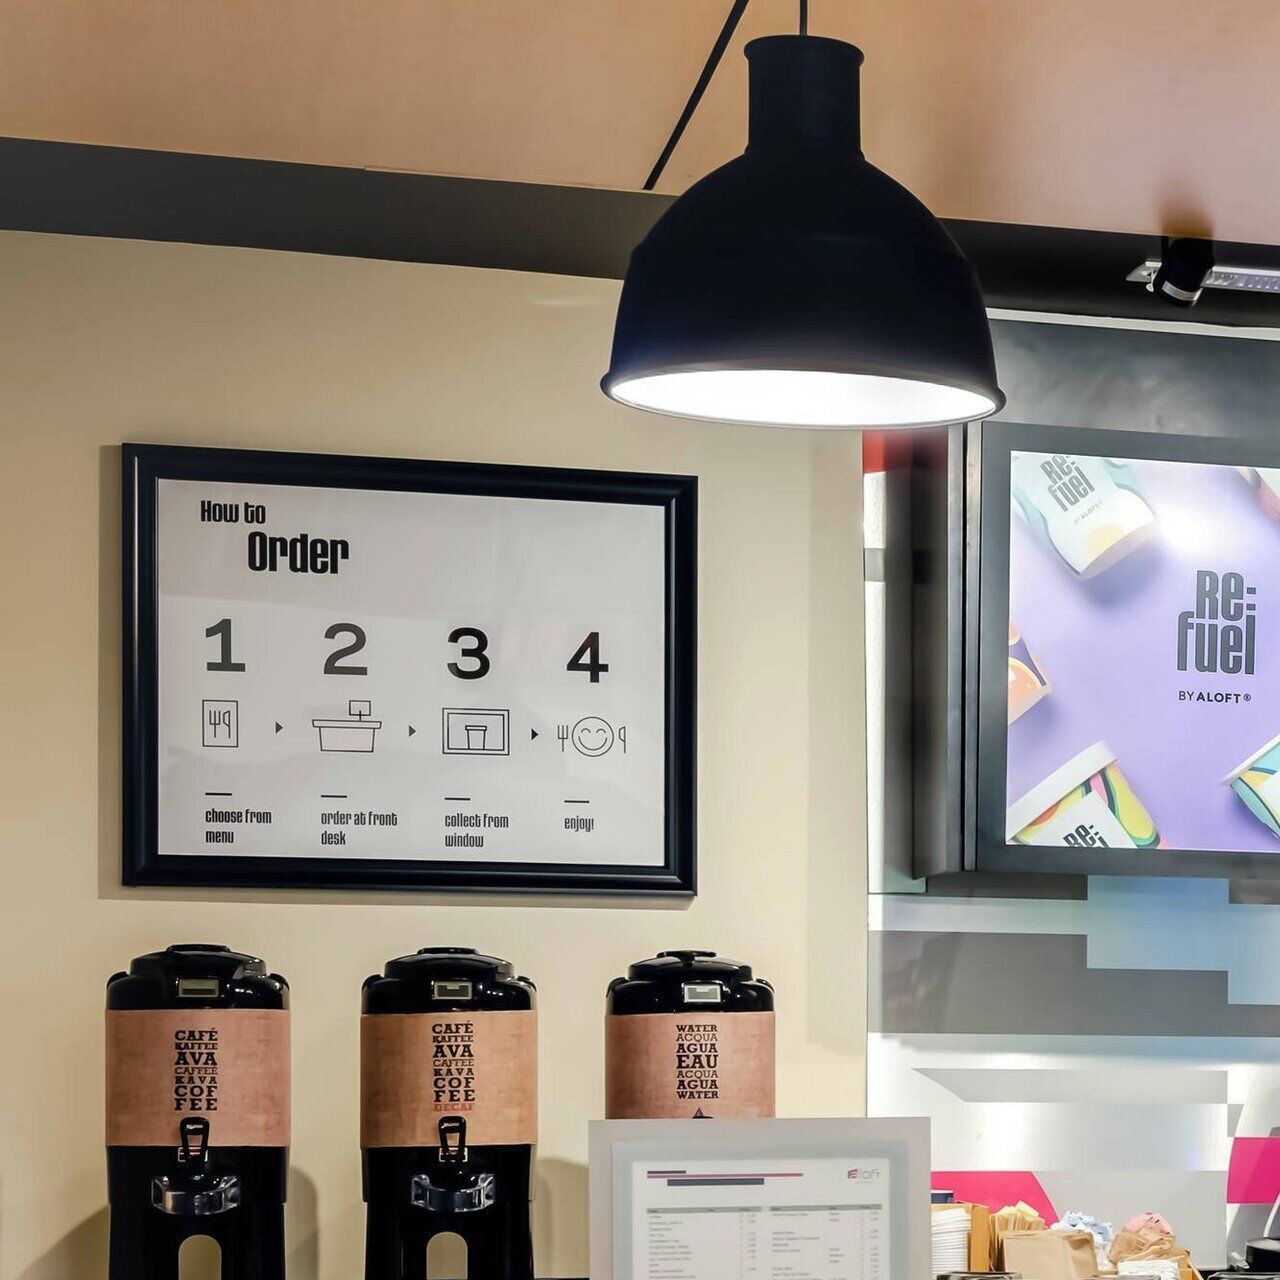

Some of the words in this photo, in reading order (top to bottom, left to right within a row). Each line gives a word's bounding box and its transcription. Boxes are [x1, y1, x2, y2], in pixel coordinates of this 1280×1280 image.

[1048, 466, 1095, 512] fuel
[201, 500, 239, 523] How
[244, 502, 266, 524] to
[248, 531, 349, 574] Order
[1196, 570, 1256, 622] Re:
[1177, 611, 1256, 675] fuel
[206, 619, 245, 672] 1
[324, 623, 367, 675] 2
[447, 627, 490, 680] 3
[567, 632, 608, 683] 4
[1178, 690, 1194, 701] BY
[206, 808, 242, 823] choose
[245, 809, 271, 823] from
[321, 811, 351, 825] order
[354, 812, 366, 825] at
[369, 811, 397, 826] front
[445, 813, 481, 827] collect
[483, 814, 508, 828] from
[565, 815, 594, 832] enjoy!
[206, 831, 234, 843] menu
[321, 831, 345, 845] desk
[445, 833, 483, 847] window
[174, 1027, 218, 1041] CAFÉ
[432, 1020, 474, 1034] CAFÉ
[676, 1033, 718, 1042] ACQUA
[432, 1044, 474, 1058] AVA
[676, 1043, 718, 1053] AGUA
[174, 1052, 218, 1065] AVA
[676, 1055, 718, 1069] EAU
[676, 1070, 718, 1079] ACQUA
[433, 1077, 475, 1089] COF
[677, 1080, 719, 1090] AGUA
[174, 1085, 218, 1097] COF
[434, 1090, 476, 1102] FEE
[677, 1091, 719, 1100] WATER
[174, 1098, 218, 1111] FEE
[434, 1103, 475, 1111] DECAF
